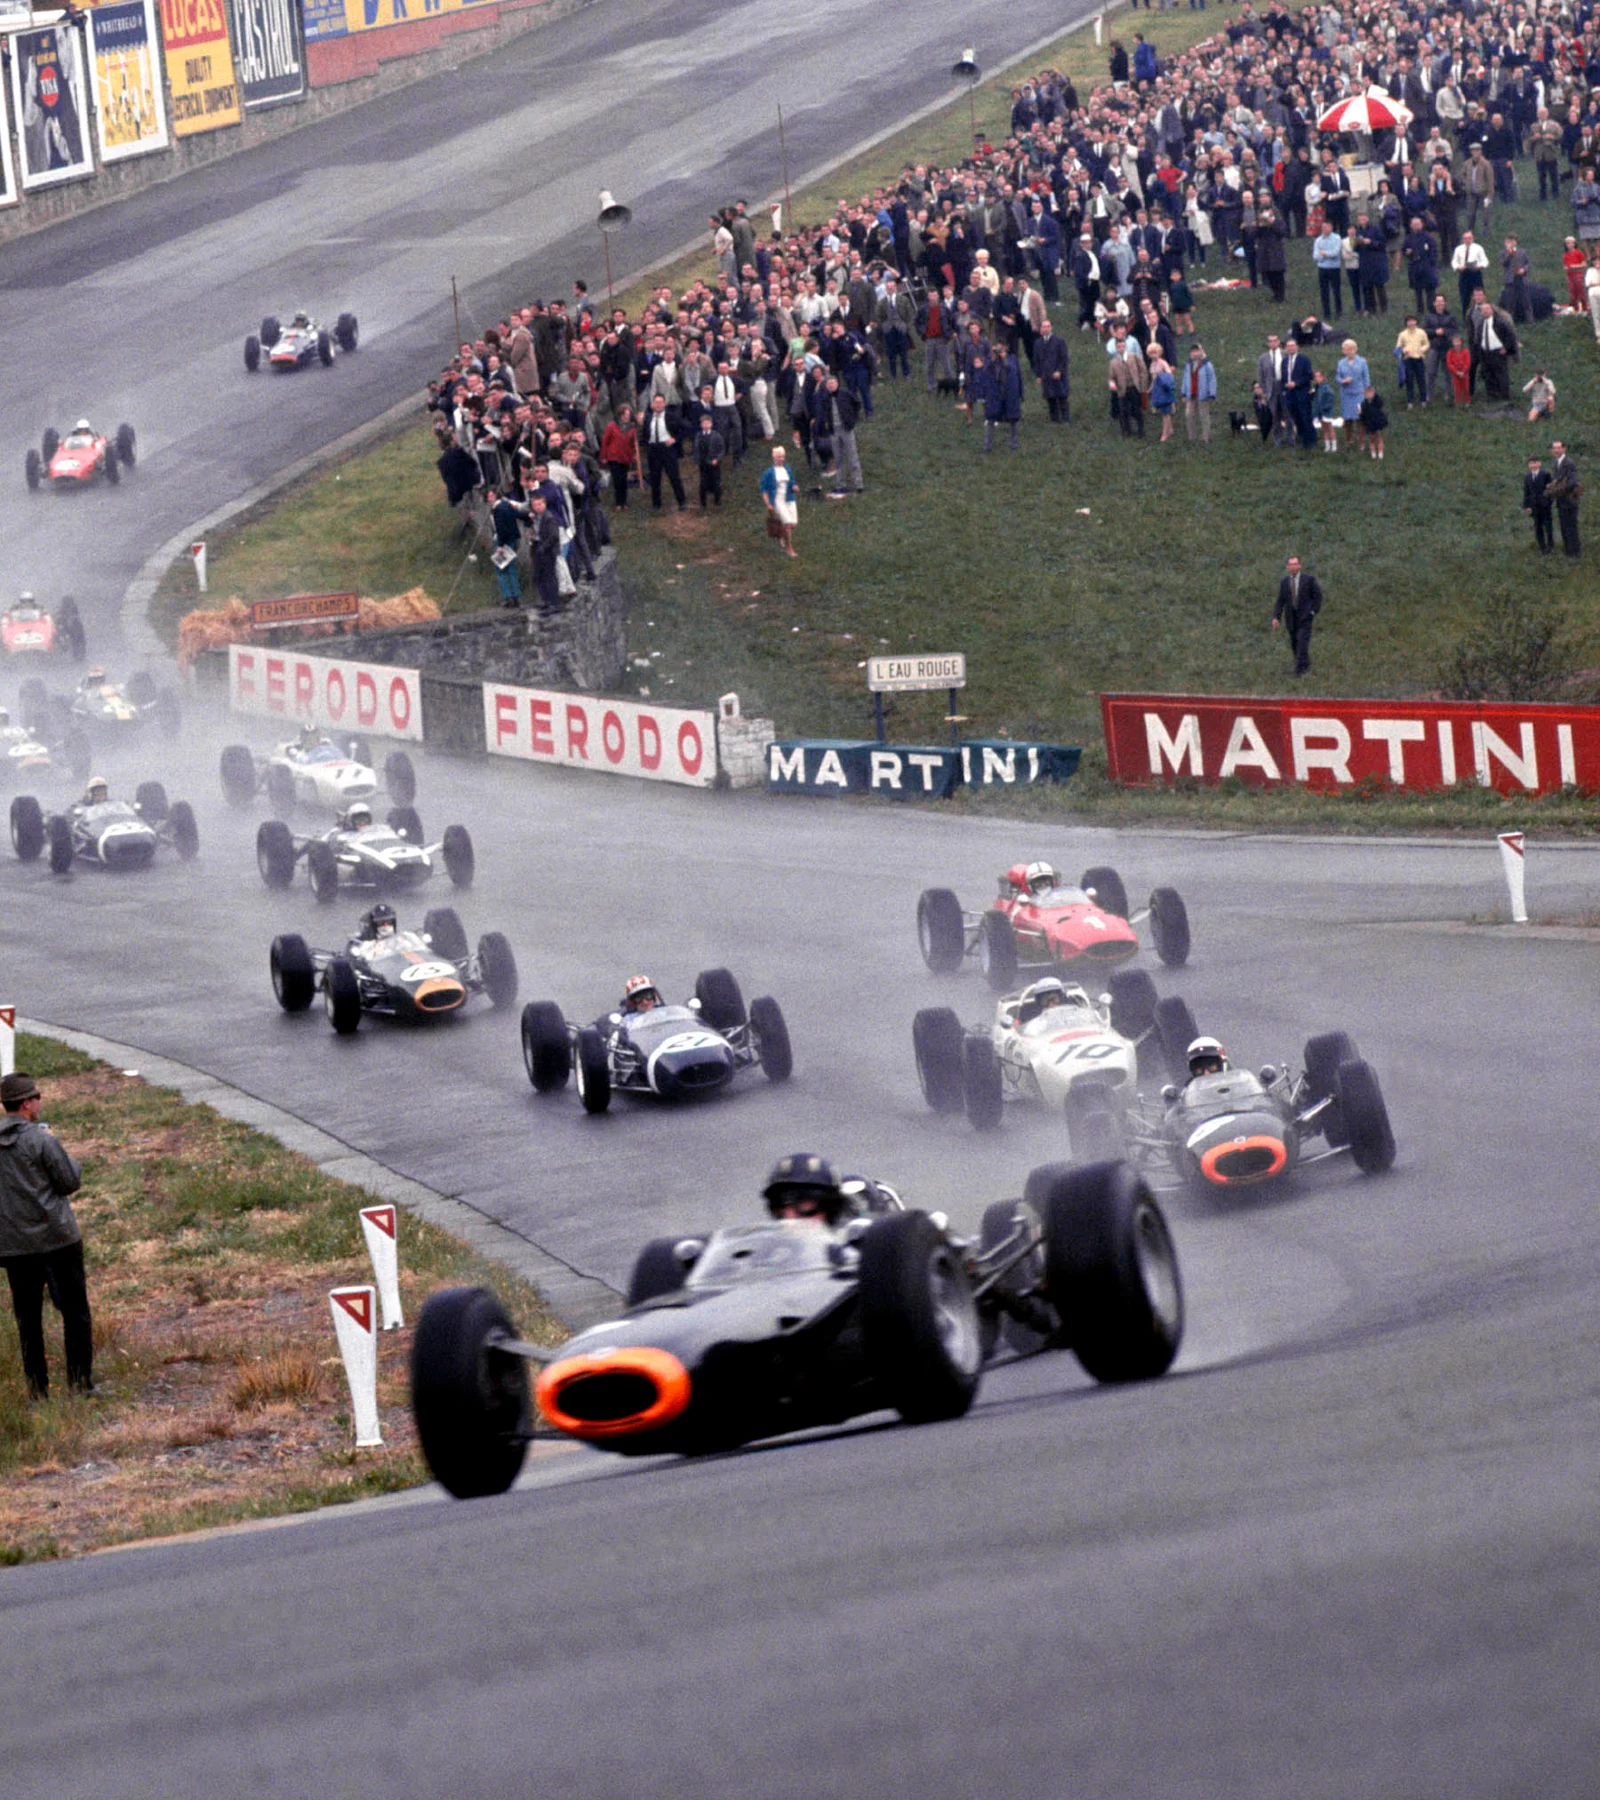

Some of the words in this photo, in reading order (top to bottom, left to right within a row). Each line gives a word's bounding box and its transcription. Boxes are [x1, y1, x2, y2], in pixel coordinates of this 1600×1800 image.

[162, 0, 223, 41] LUCAS
[233, 0, 300, 84] CASTROL
[259, 597, 351, 617] FRANCORCHAMPS
[237, 653, 412, 731] FERODO
[888, 662, 912, 679] EAU
[917, 660, 959, 677] ROUGE
[495, 693, 704, 777] FERODO
[1143, 712, 1578, 790] MARTINI
[769, 744, 1039, 791] MARTINI
[1055, 1043, 1125, 1066] 10
